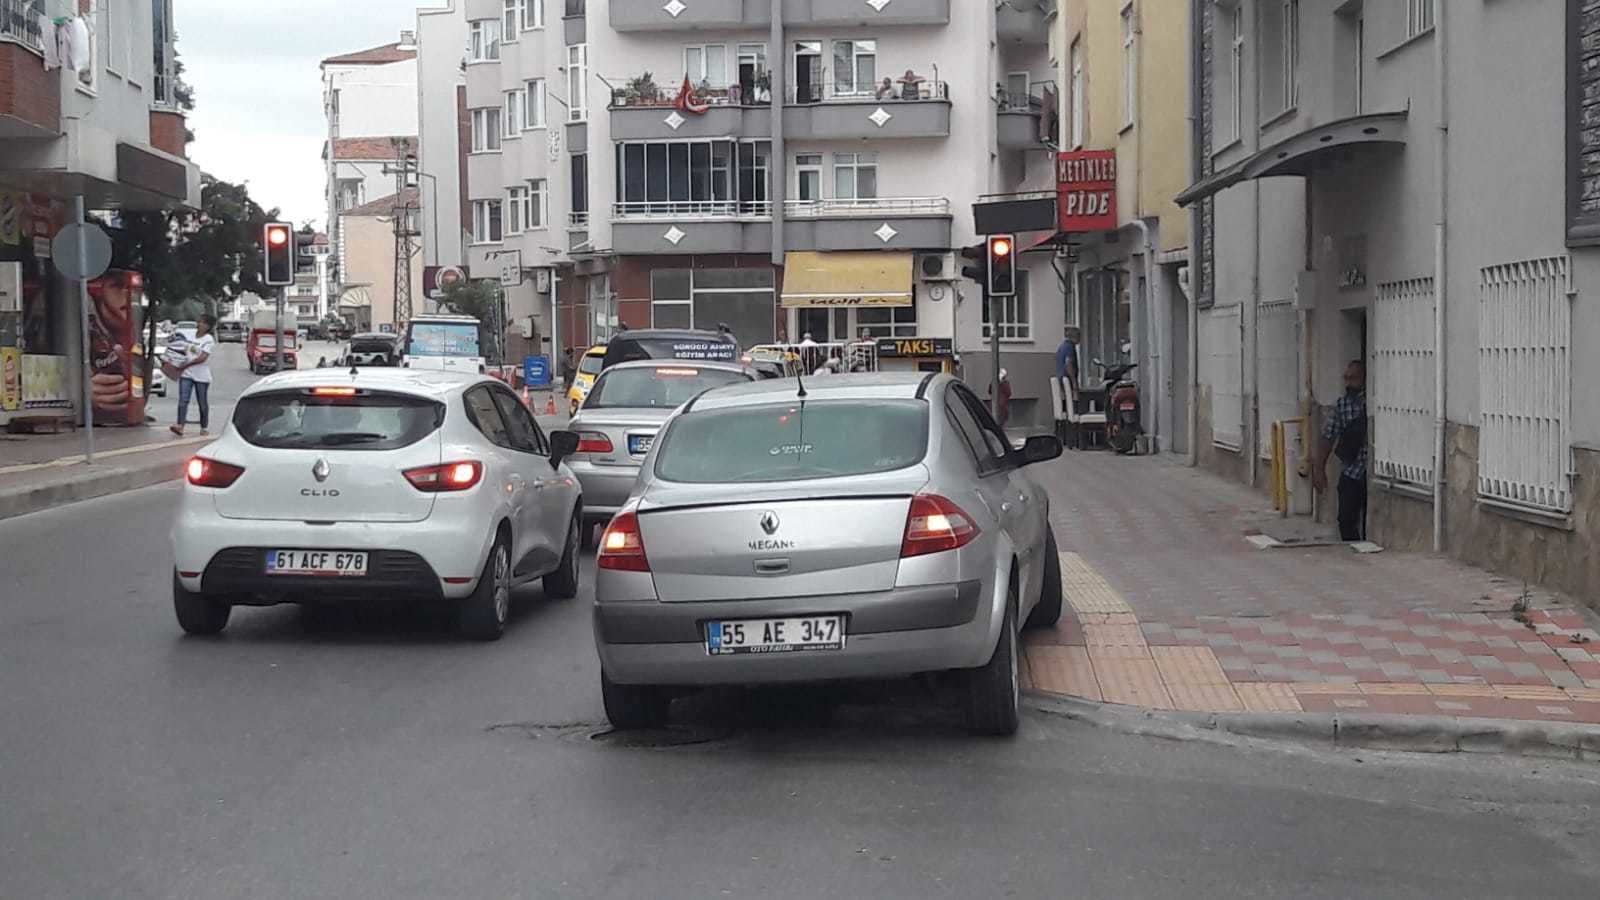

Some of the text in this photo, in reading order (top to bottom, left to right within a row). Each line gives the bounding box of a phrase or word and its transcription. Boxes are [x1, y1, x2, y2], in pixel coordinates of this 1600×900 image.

[1067, 190, 1110, 215] PİDE
[300, 488, 341, 497] CLIO
[277, 551, 364, 570] 61 ACF 678
[721, 624, 745, 645] 55
[763, 621, 786, 643] AE
[801, 618, 837, 641] 347
